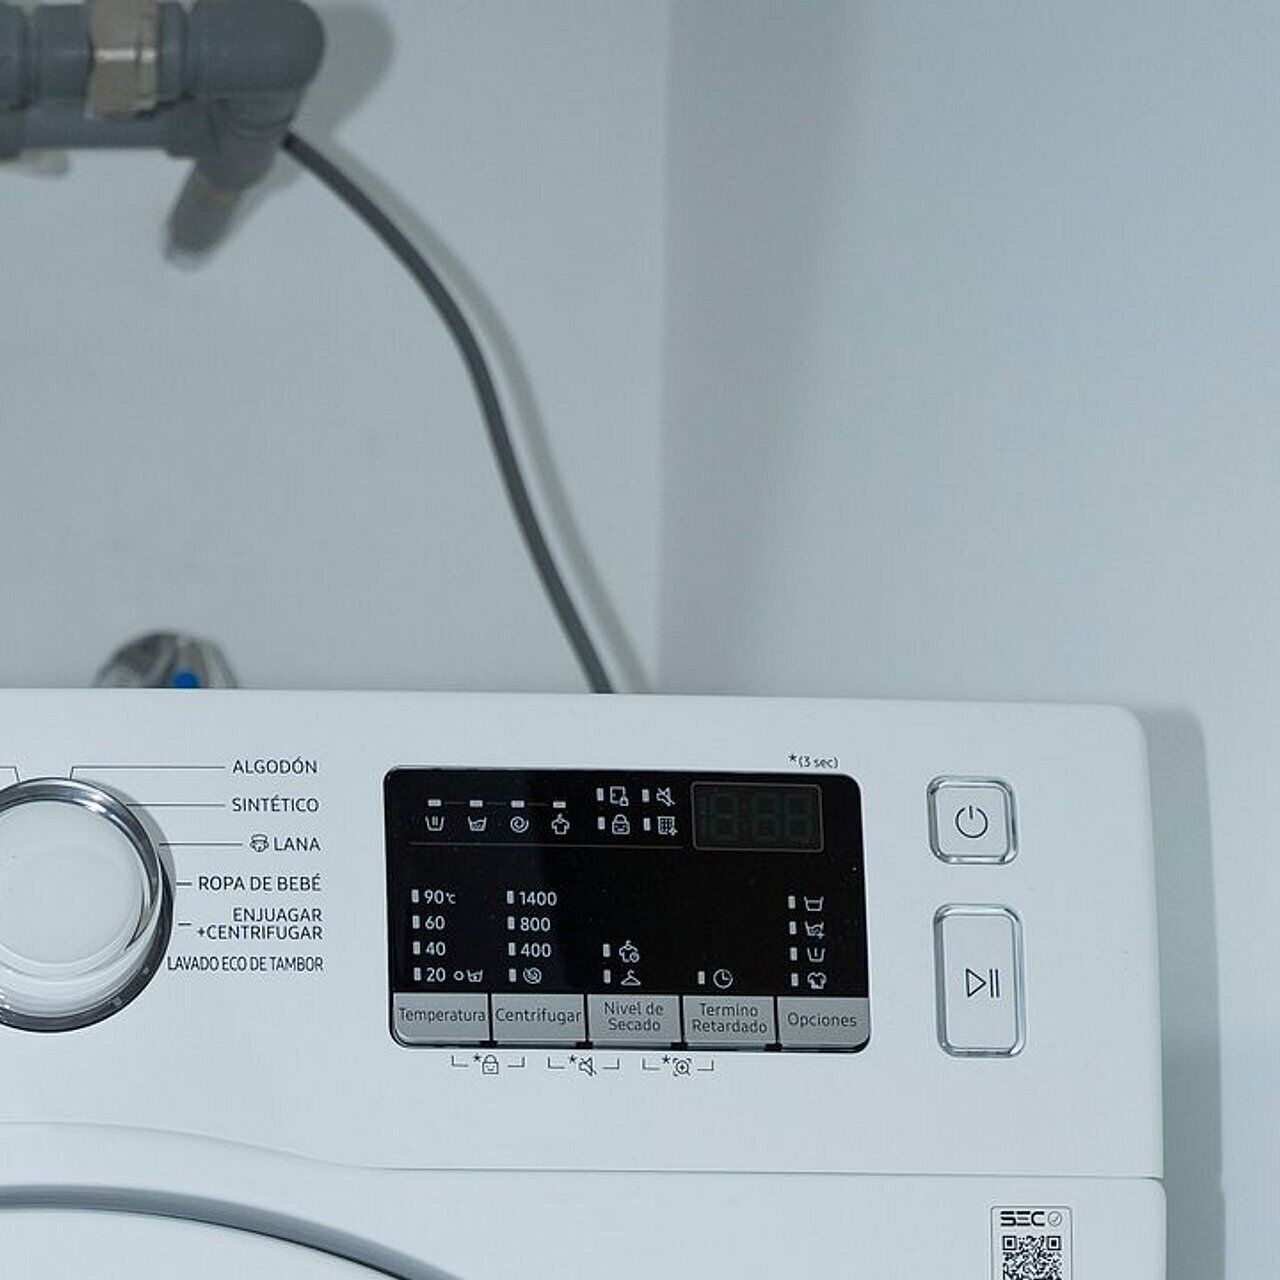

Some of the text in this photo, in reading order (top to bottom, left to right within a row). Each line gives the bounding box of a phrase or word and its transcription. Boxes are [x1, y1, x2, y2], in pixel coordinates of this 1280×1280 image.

[232, 755, 318, 775] ALGODÓN
[814, 756, 839, 769] sec)
[232, 794, 320, 812] SINTÉTICO
[273, 836, 322, 852] LANA
[198, 873, 322, 892] ROPA DE BEBÉ
[519, 891, 558, 906] 1400
[233, 906, 323, 923] ENJUAGAR
[424, 915, 446, 930] 60
[197, 924, 324, 940] +CENTRIFUGAR
[519, 916, 551, 932] 800
[424, 941, 446, 956] 40
[520, 942, 552, 957] 400
[167, 955, 324, 971] LAVADO ECO DE TAMBOR
[425, 967, 447, 982] 20
[398, 1007, 486, 1025] Temperatura
[495, 1007, 582, 1025] Centrifugar
[603, 1000, 665, 1016] Nivel de
[699, 1002, 759, 1018] Termino
[607, 1017, 661, 1032] Secado
[692, 1018, 768, 1034] Retardado
[787, 1012, 858, 1030] Opciones
[1000, 1210, 1046, 1227] SEC
